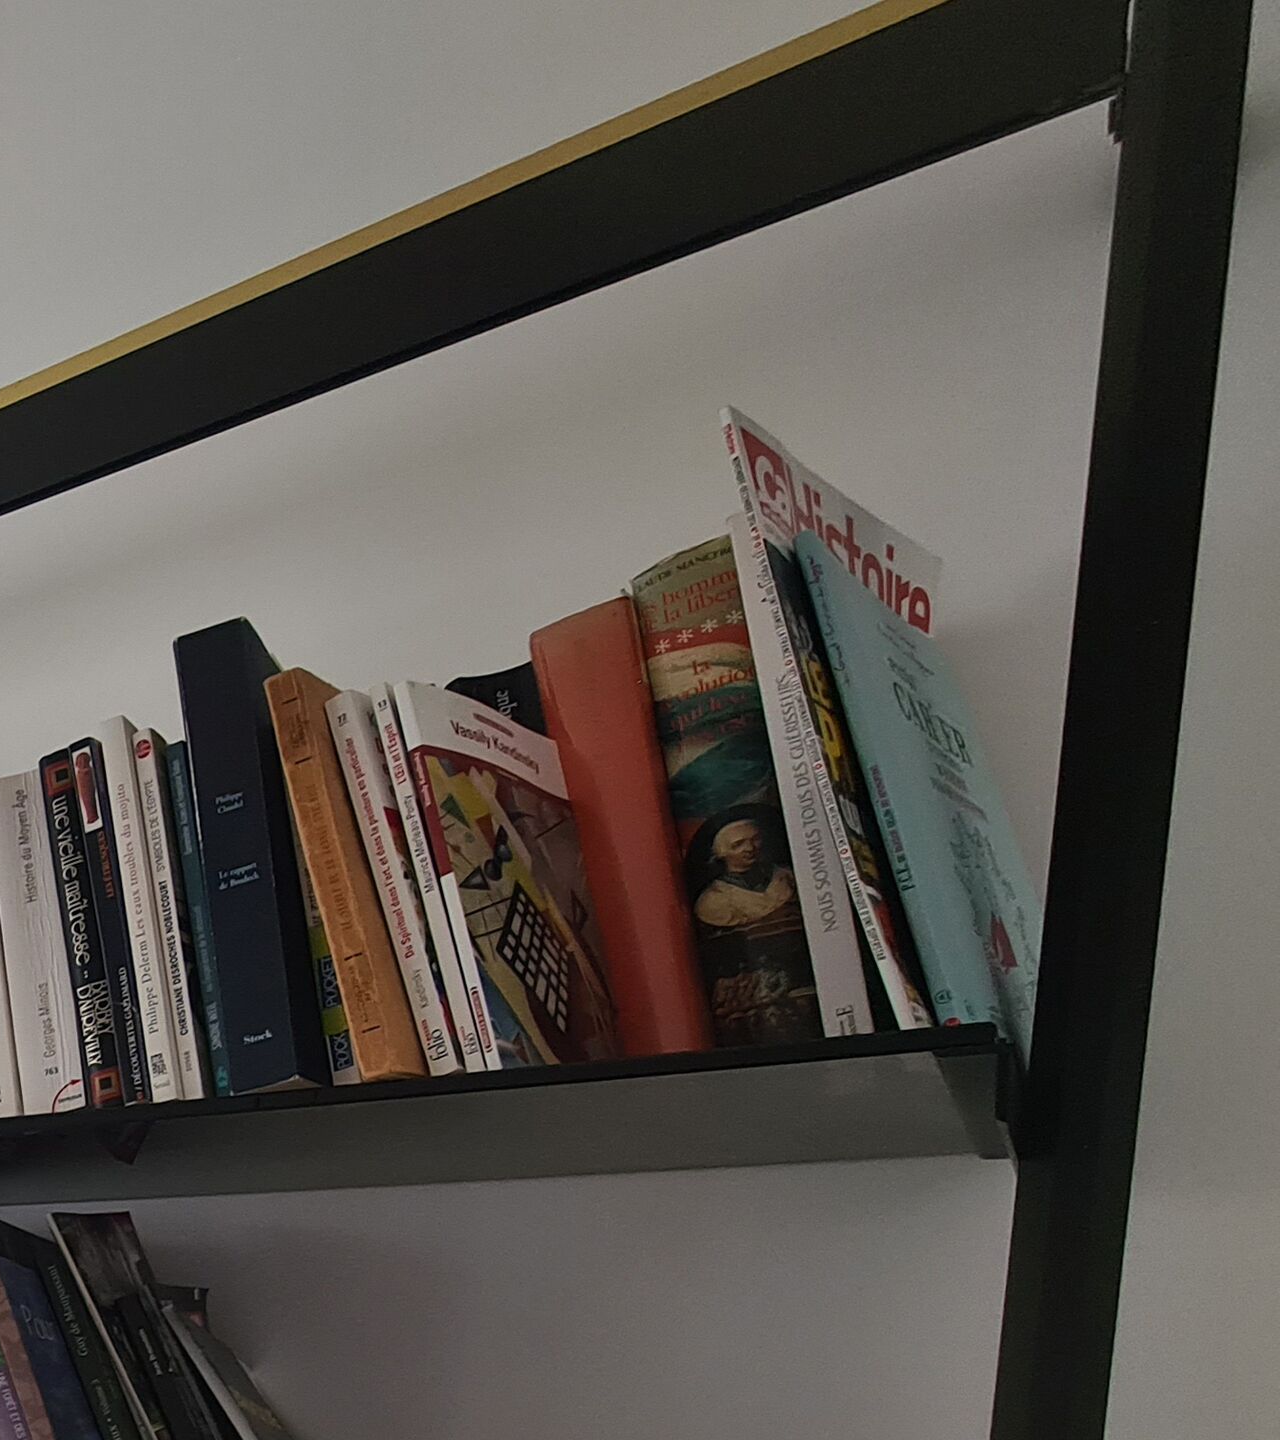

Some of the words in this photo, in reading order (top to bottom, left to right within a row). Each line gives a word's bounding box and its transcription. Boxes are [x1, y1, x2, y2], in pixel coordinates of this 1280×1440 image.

[383, 722, 398, 753] l'Esprit
[789, 760, 811, 788] DES
[13, 788, 27, 809] Âge
[50, 794, 68, 825] une
[116, 782, 133, 821] mojito
[364, 794, 383, 825] peinture
[794, 788, 819, 828] TOUS
[16, 811, 34, 845] Moyen
[122, 823, 133, 839] du
[403, 793, 427, 854] Merleau-Ponty
[21, 847, 32, 860] du
[54, 825, 83, 878] vieille
[124, 840, 142, 886] troubles
[376, 837, 390, 856] dans
[802, 827, 832, 890] SOMMES
[21, 862, 38, 904] Histoire
[414, 856, 436, 894] Maurice
[132, 888, 146, 915] eaux
[157, 879, 177, 934] NOBLECOURT
[387, 889, 402, 907] dans
[815, 890, 840, 933] NOUS
[61, 880, 92, 967] maîtresse
[134, 918, 148, 938] Les
[393, 907, 414, 945] Spirituel
[138, 940, 154, 984] Delerm
[166, 934, 183, 986] DESROCHES
[403, 946, 416, 959] Du
[37, 982, 50, 1016] Minois
[91, 979, 115, 1035] BARBEY
[143, 986, 160, 1035] Philippe
[174, 986, 189, 1036] CHRISTIANE
[38, 1019, 57, 1059] Georges
[124, 1021, 143, 1085] DÉCOUVERTES
[243, 1030, 273, 1044] Stock
[428, 1028, 449, 1061] folio
[47, 1263, 77, 1324] Maupassant
[75, 1338, 89, 1358] Guy
